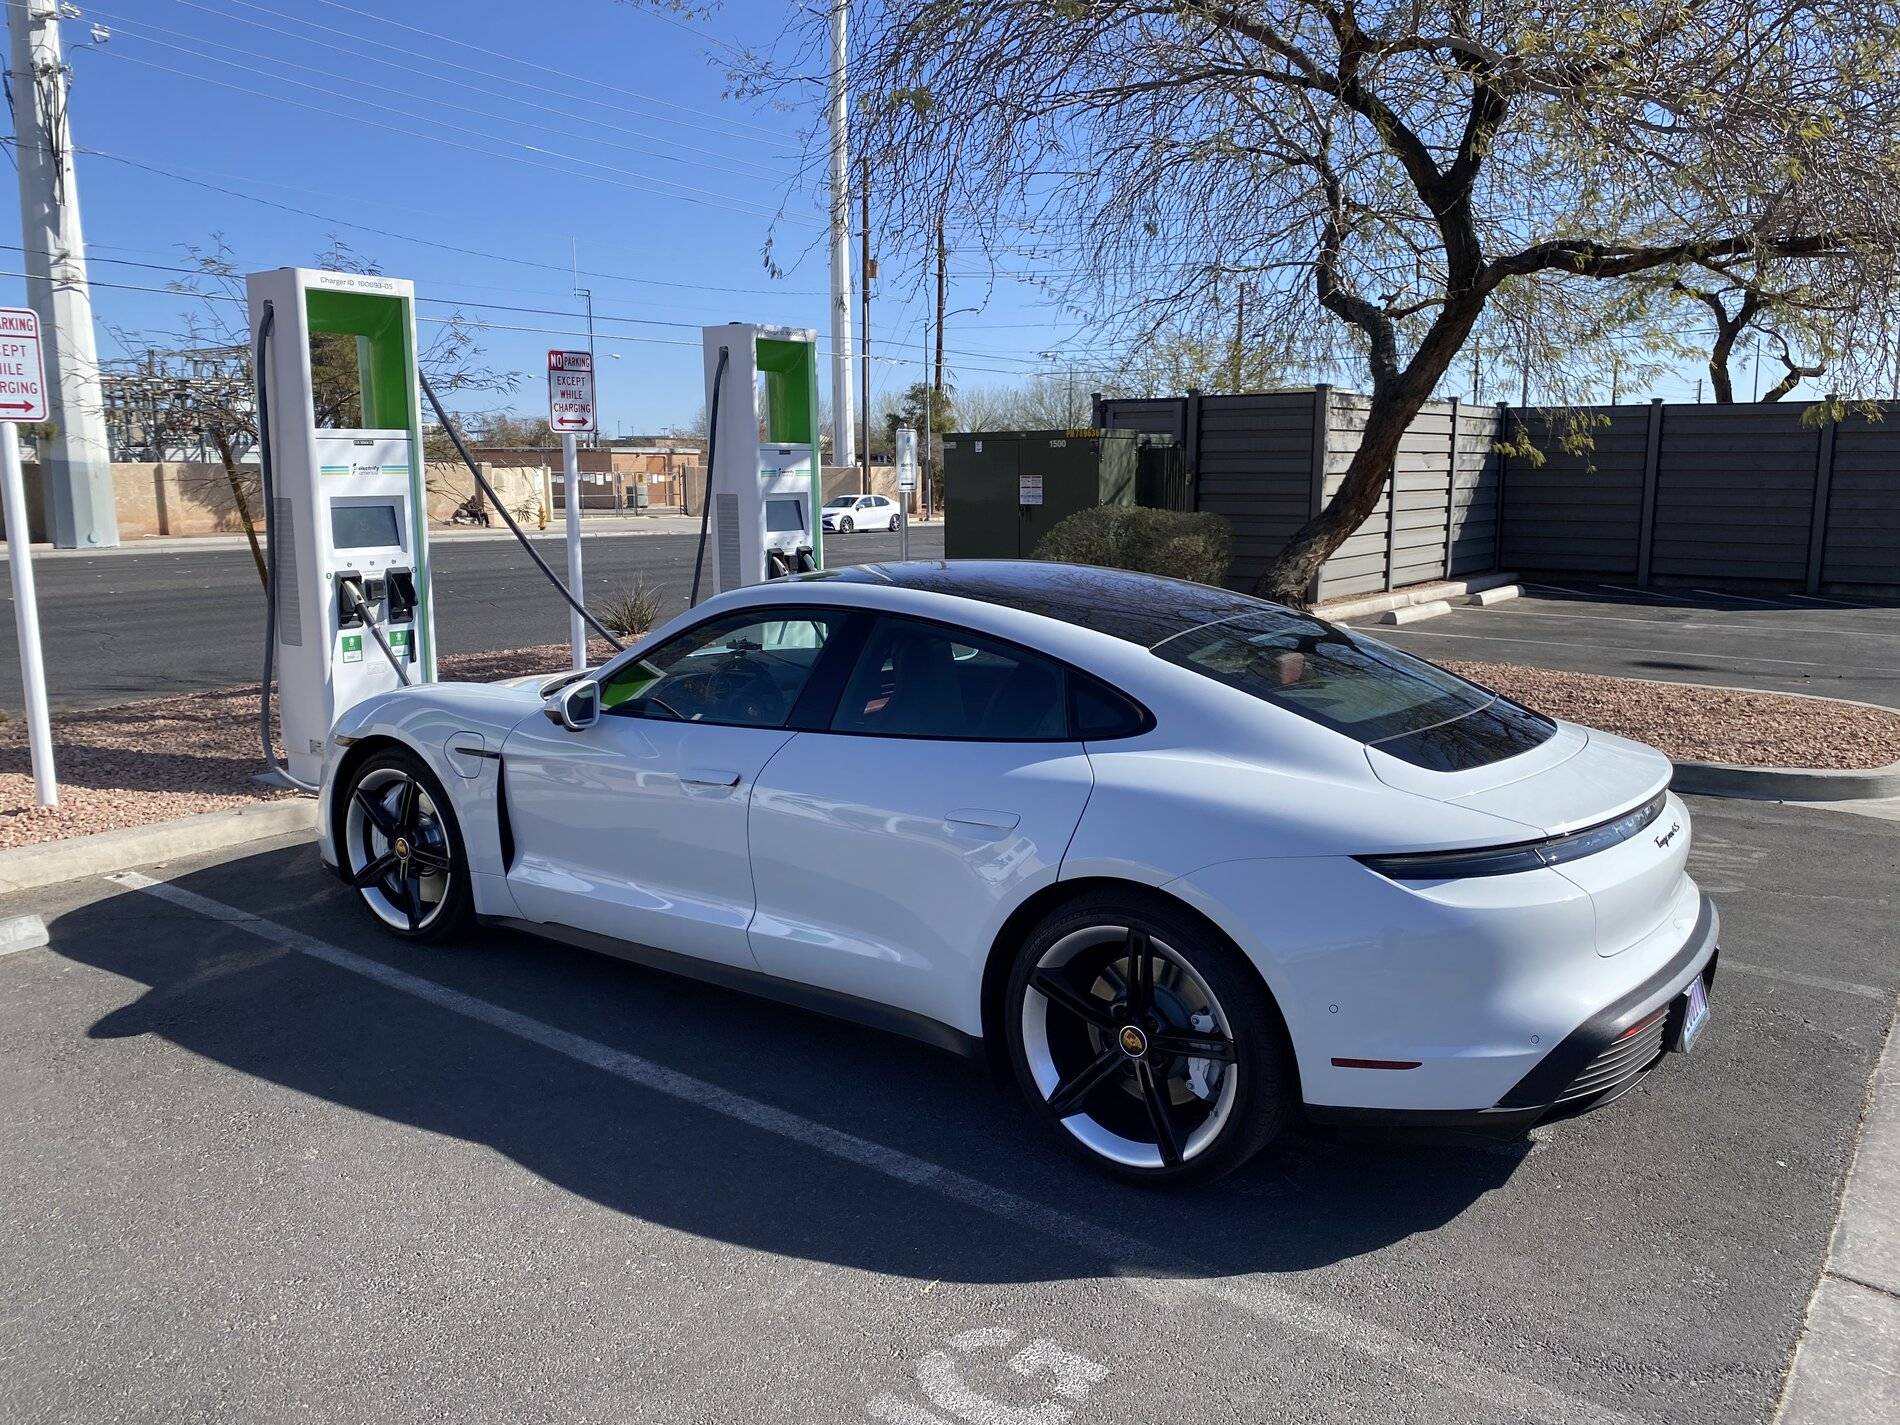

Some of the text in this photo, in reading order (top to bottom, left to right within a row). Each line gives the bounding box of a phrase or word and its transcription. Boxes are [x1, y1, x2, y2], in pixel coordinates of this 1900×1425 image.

[320, 276, 346, 287] Charger
[0, 317, 33, 331] RKING
[0, 345, 26, 357] EPT
[551, 354, 590, 367] NO PARKING
[557, 376, 585, 386] EXCEPT
[560, 390, 583, 399] WHILE
[554, 403, 590, 413] CHARGING
[1049, 440, 1067, 448] 1500
